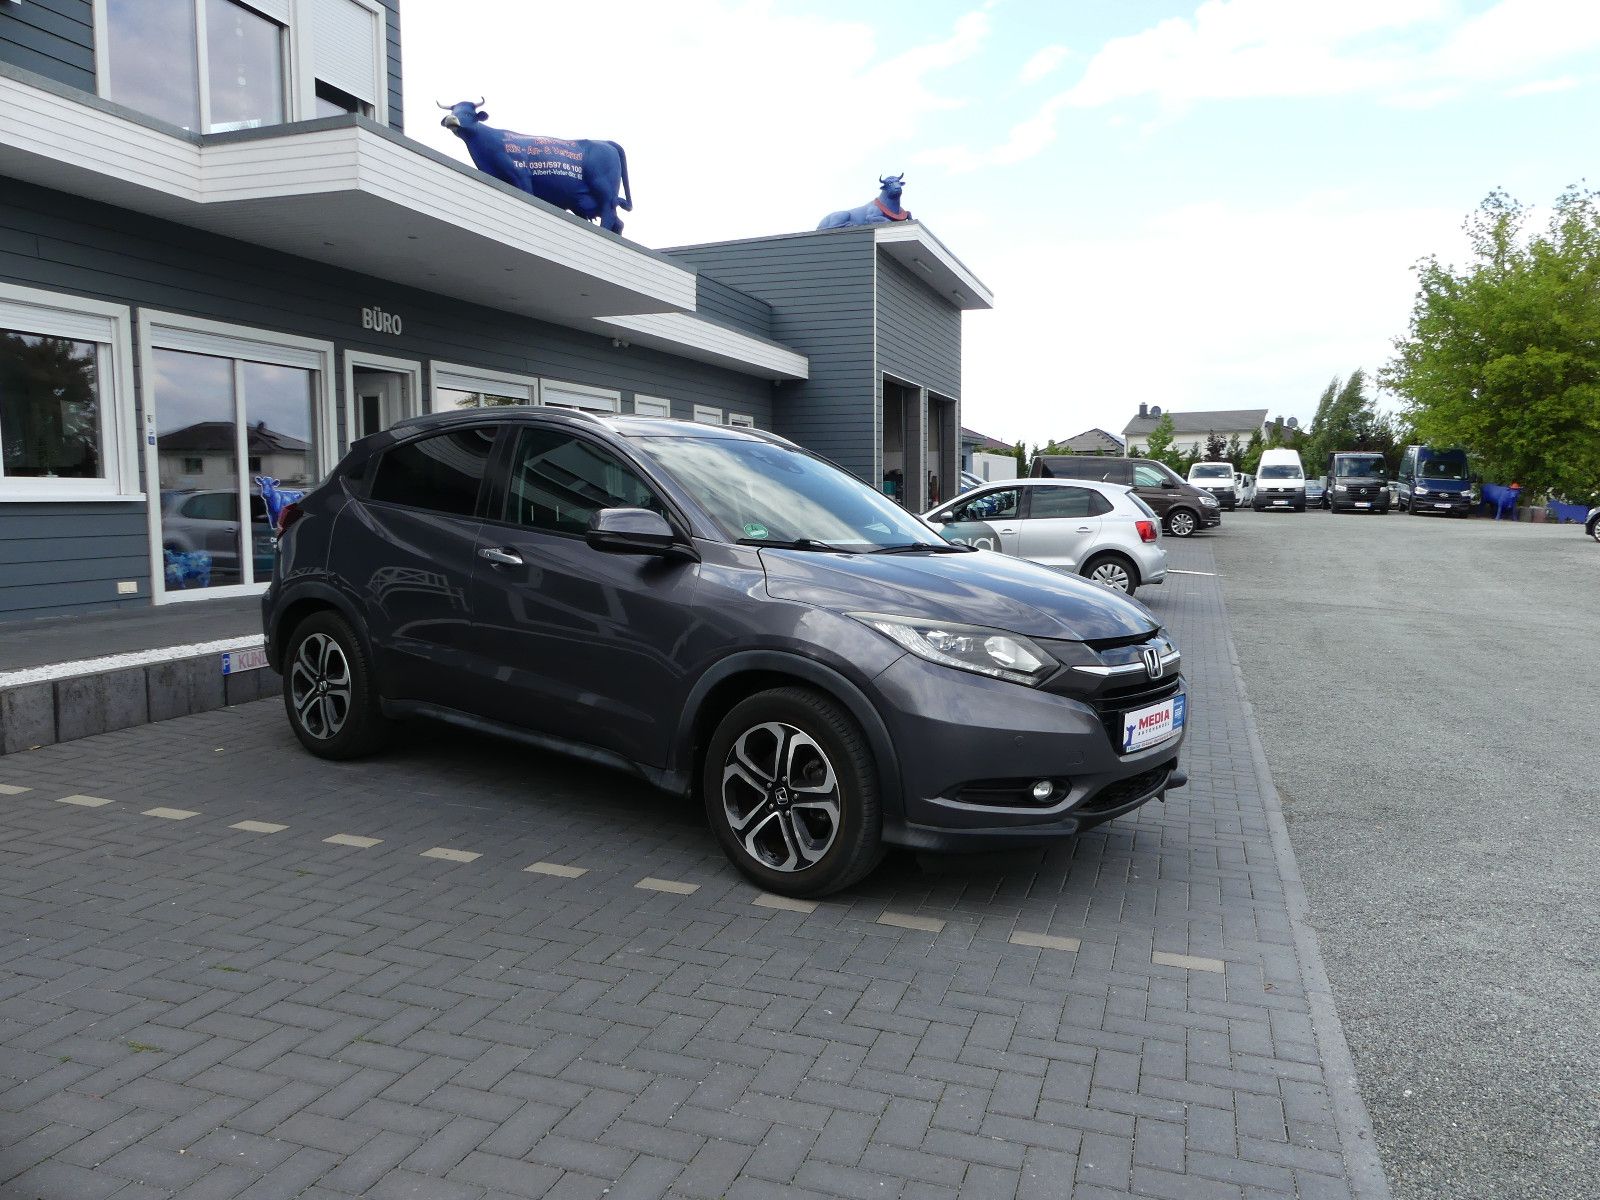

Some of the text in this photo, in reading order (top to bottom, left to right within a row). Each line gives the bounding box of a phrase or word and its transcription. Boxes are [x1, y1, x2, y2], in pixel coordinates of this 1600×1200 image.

[513, 160, 528, 168] Tel.
[361, 306, 402, 336] BÜRO
[1138, 709, 1170, 730] MEDIA
